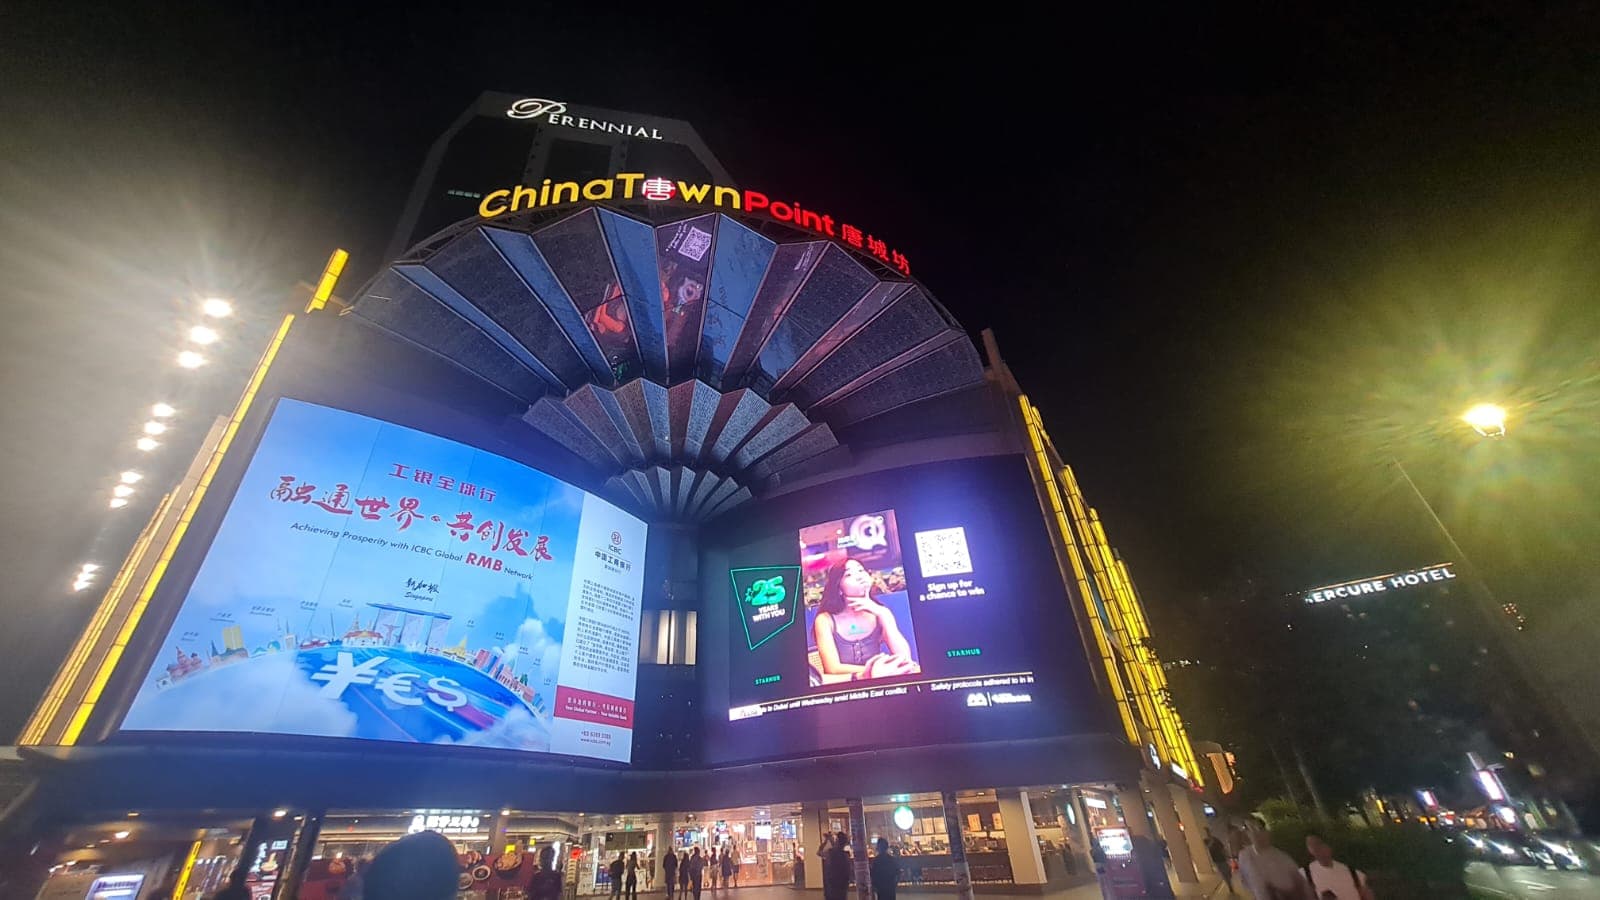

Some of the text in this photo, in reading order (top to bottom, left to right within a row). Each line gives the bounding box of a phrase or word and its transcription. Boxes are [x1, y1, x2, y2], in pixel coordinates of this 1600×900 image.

[507, 98, 663, 140] PERENNIAL
[744, 190, 835, 236] Point
[841, 223, 910, 276] 唐城坊
[388, 463, 497, 503] 工银全球行
[290, 521, 534, 581] Achieving Prosperity with ICBC Global RMB Network
[608, 544, 623, 555] ICBC
[1391, 567, 1456, 588] HOTEL
[752, 575, 786, 606] 25
[919, 586, 985, 602] a chance to win
[927, 579, 973, 593] Sign up for
[752, 608, 785, 622] WITH YOU
[758, 603, 779, 613] YEARS
[947, 648, 981, 658] STARHUB
[755, 674, 781, 686] STARHUB
[930, 682, 952, 691] Safety
[952, 679, 983, 690] protocols
[983, 677, 1011, 686] adhered
[801, 696, 834, 707] Wednesday
[849, 691, 869, 700] Middle
[870, 689, 884, 697] East
